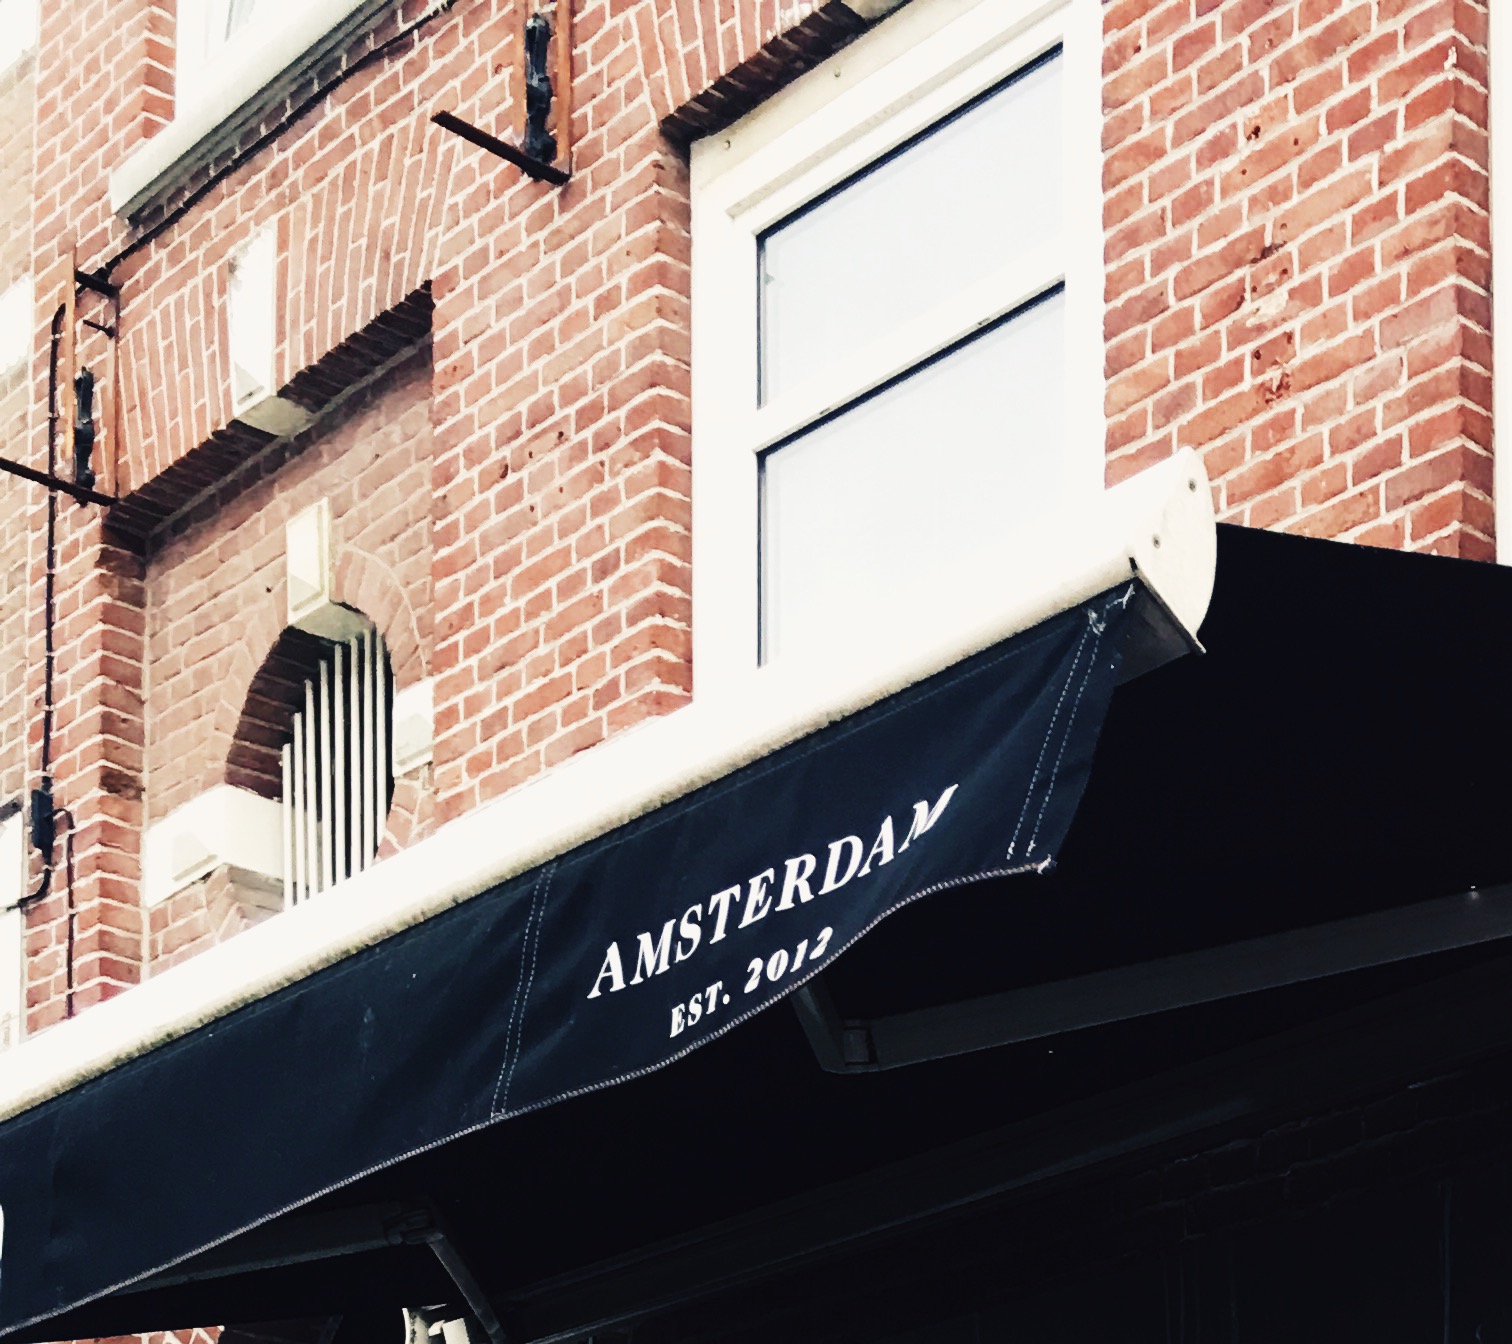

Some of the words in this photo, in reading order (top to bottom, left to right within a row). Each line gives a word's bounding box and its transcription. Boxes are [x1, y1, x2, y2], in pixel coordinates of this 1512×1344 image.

[586, 783, 959, 1000] AMSTERDAM
[669, 981, 730, 1039] EST.
[743, 926, 834, 994] 2012
